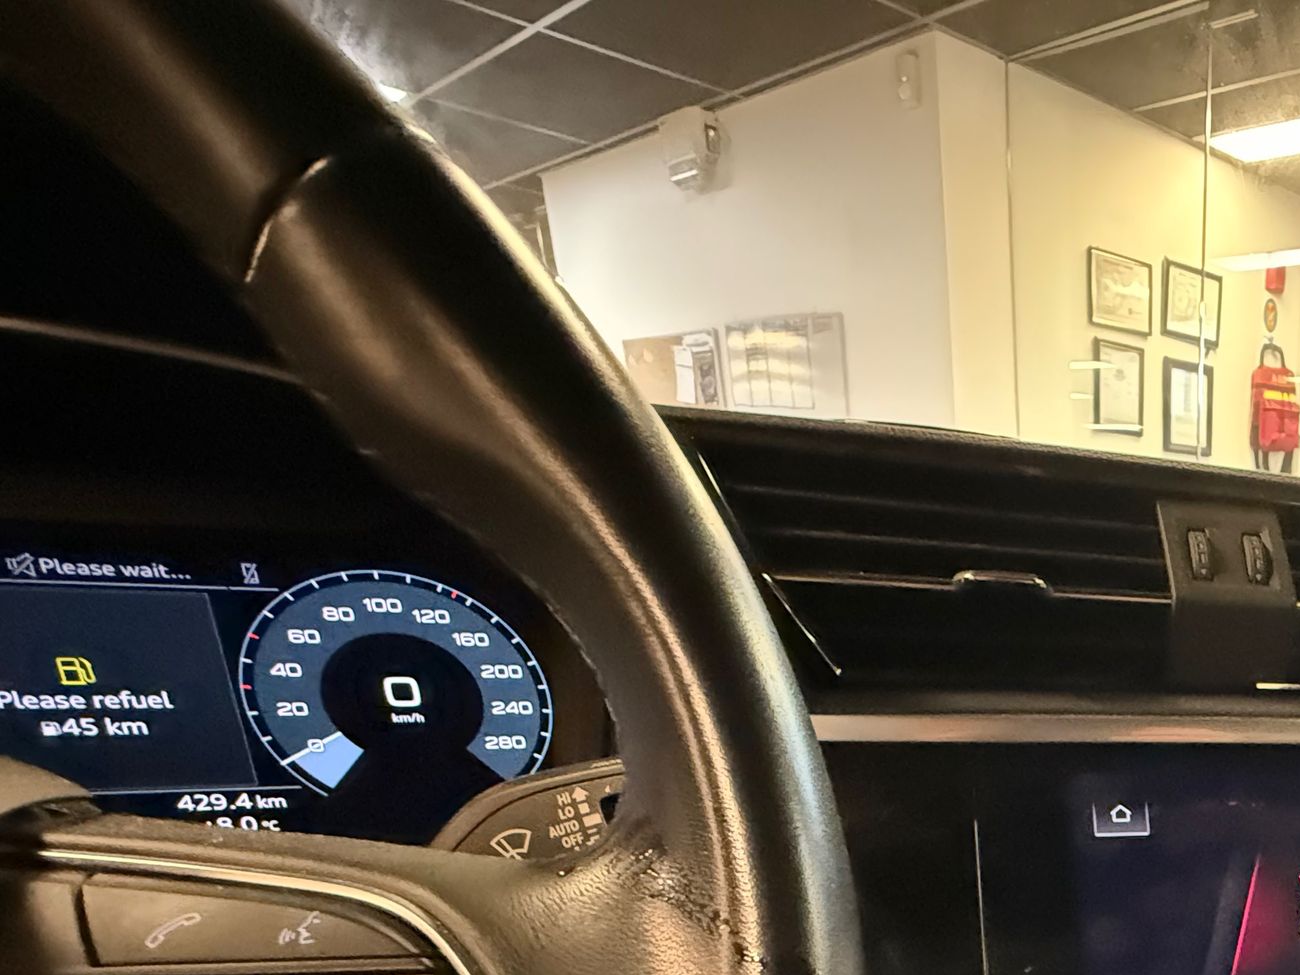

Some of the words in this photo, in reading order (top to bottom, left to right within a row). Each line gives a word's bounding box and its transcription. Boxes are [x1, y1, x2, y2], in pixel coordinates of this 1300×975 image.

[38, 557, 116, 577] Please
[119, 563, 192, 580] wait...
[362, 597, 403, 614] 100
[322, 606, 355, 622] 80
[411, 609, 450, 624] 120
[287, 629, 321, 644] 60
[452, 632, 490, 647] 160
[269, 662, 303, 678] 40
[480, 664, 523, 679] 200
[0, 690, 87, 710] Please
[92, 690, 175, 710] refuel
[383, 676, 422, 708] 0
[276, 701, 309, 717] 20
[491, 701, 534, 716] 240
[62, 717, 99, 736] 45
[104, 717, 149, 736] km
[391, 713, 426, 724] km/h
[484, 735, 527, 750] 280
[177, 792, 254, 812] 429.4
[255, 794, 288, 809] km
[556, 791, 572, 806] HI
[557, 806, 575, 820] LO
[548, 820, 580, 839] AUTO
[561, 832, 584, 849] OFF
